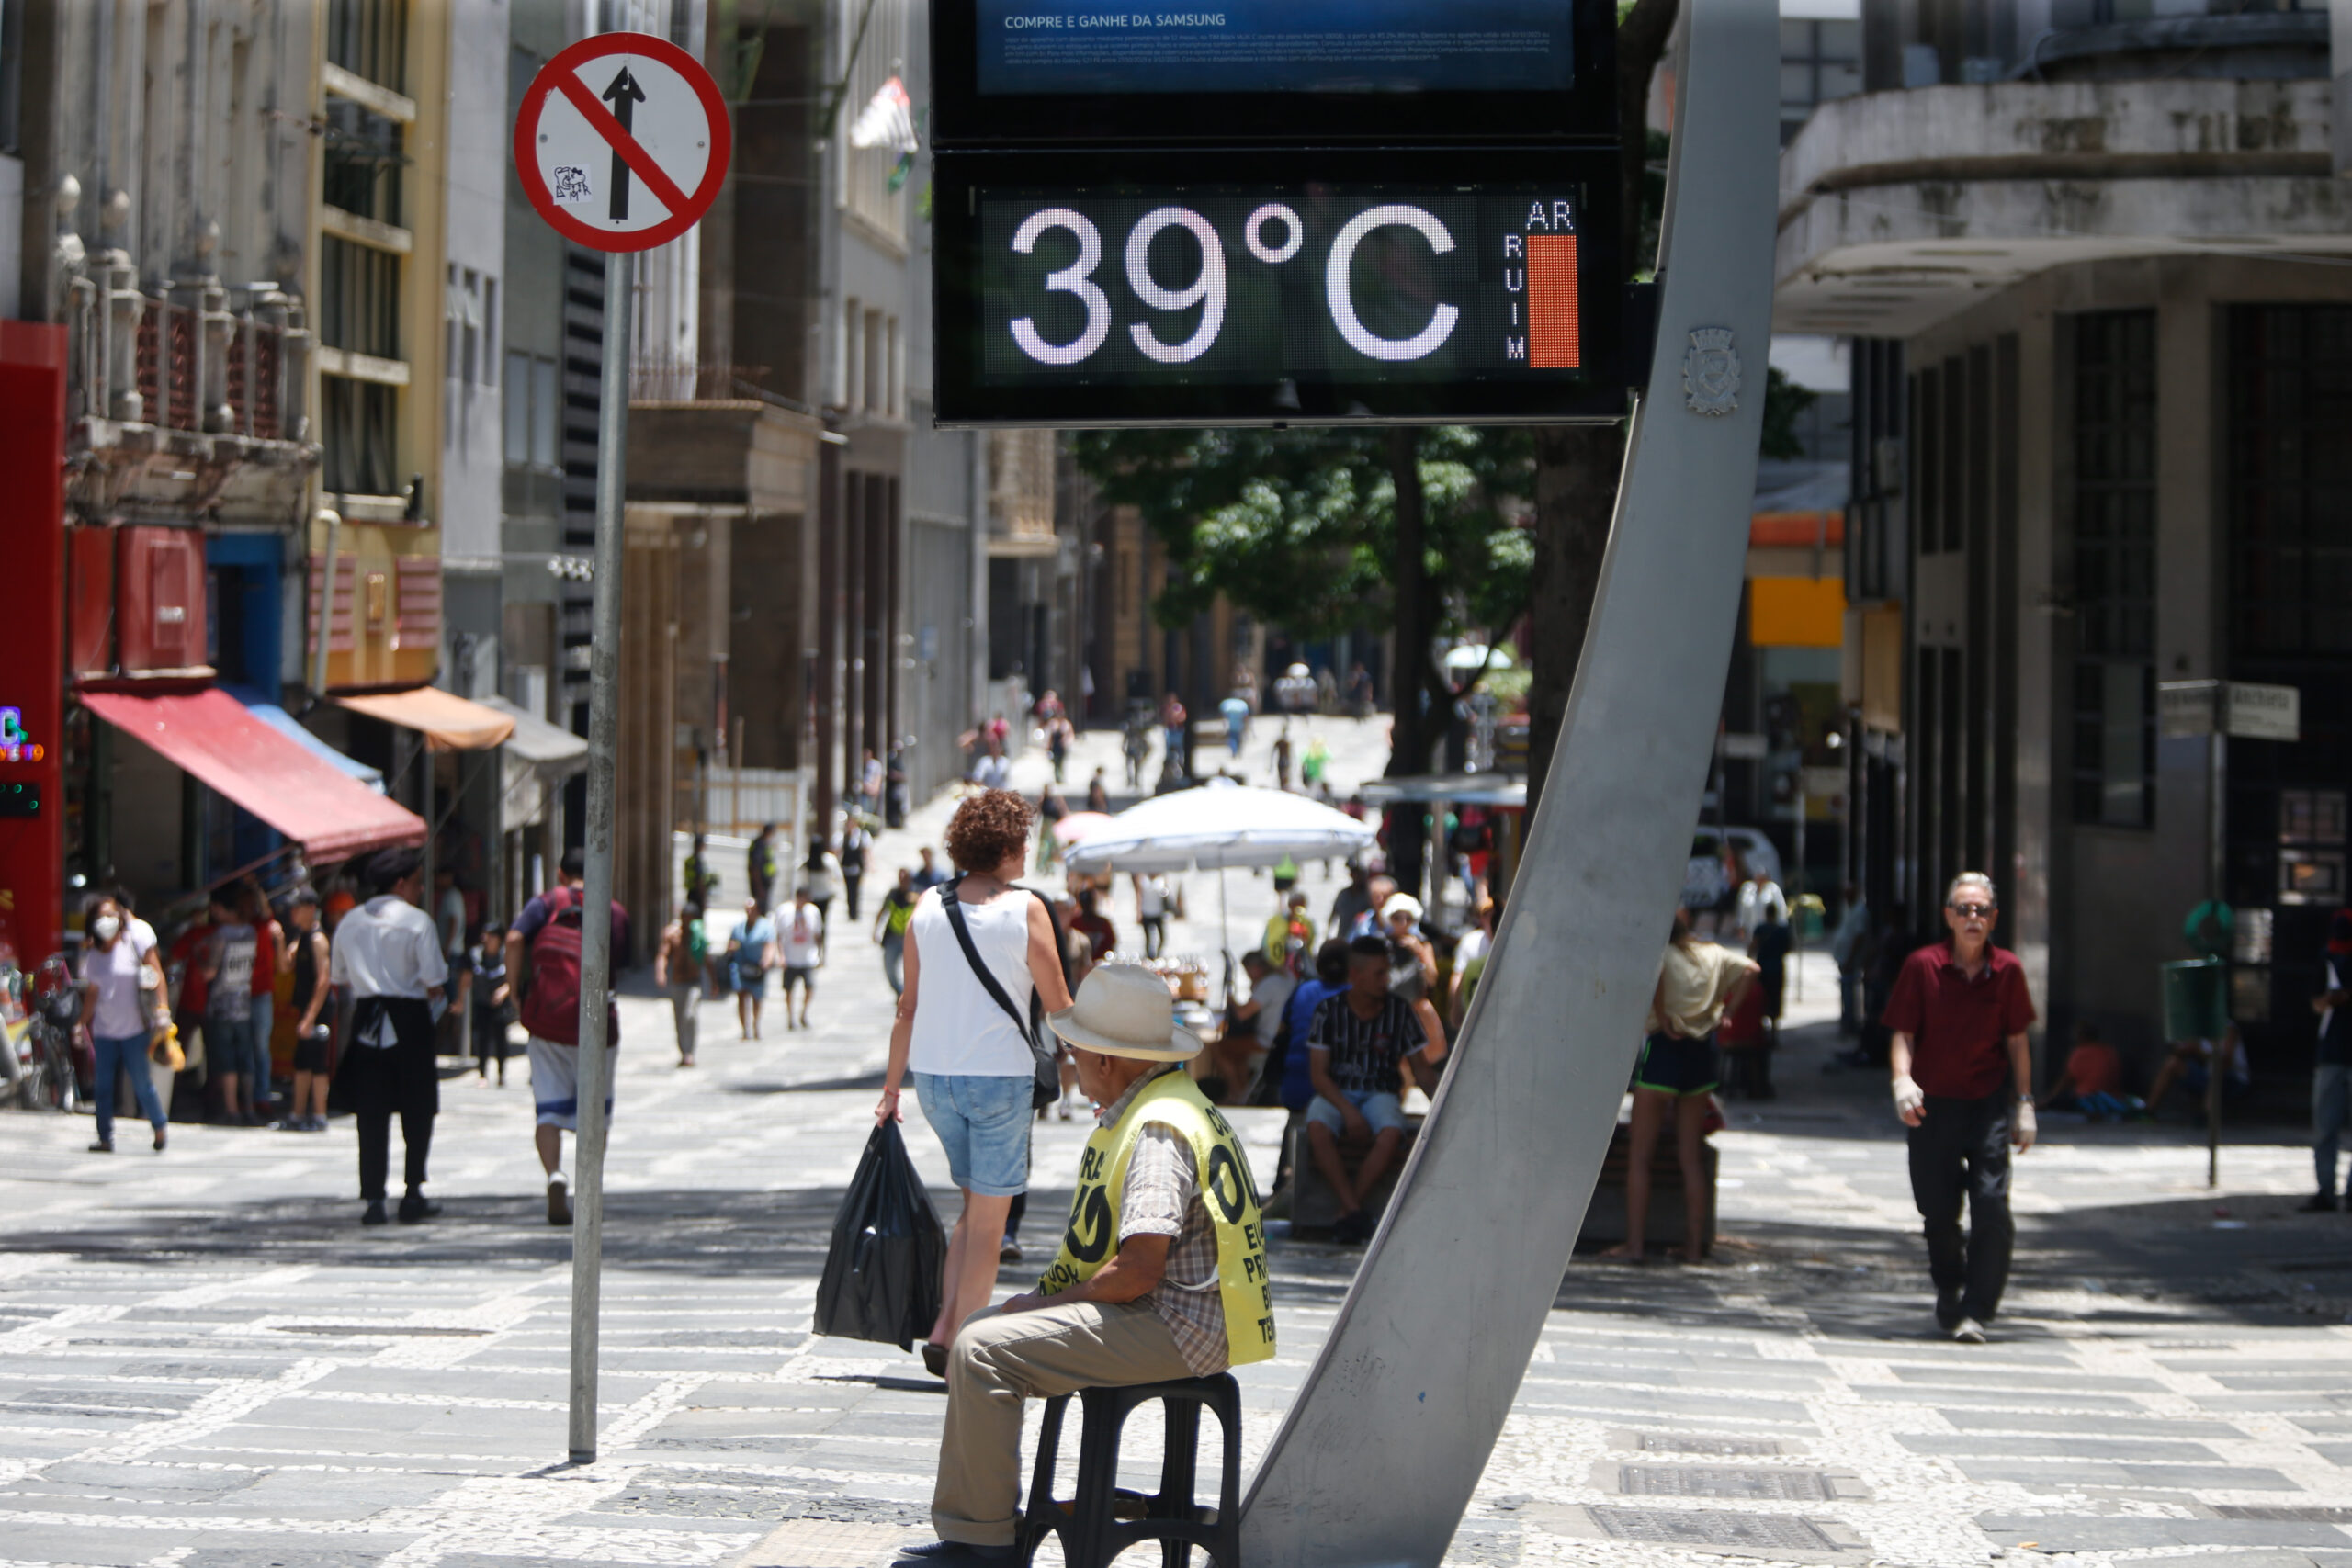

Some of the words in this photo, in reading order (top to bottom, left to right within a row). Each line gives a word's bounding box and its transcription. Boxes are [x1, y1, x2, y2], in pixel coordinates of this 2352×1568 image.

[1005, 16, 1063, 28] COMPRE
[1068, 16, 1075, 28] E
[1079, 15, 1128, 28] GANHE
[1132, 15, 1152, 27] DA
[1156, 14, 1226, 27] SAMSUNG
[1526, 200, 1575, 231] AR
[1504, 234, 1525, 360] RUIM
